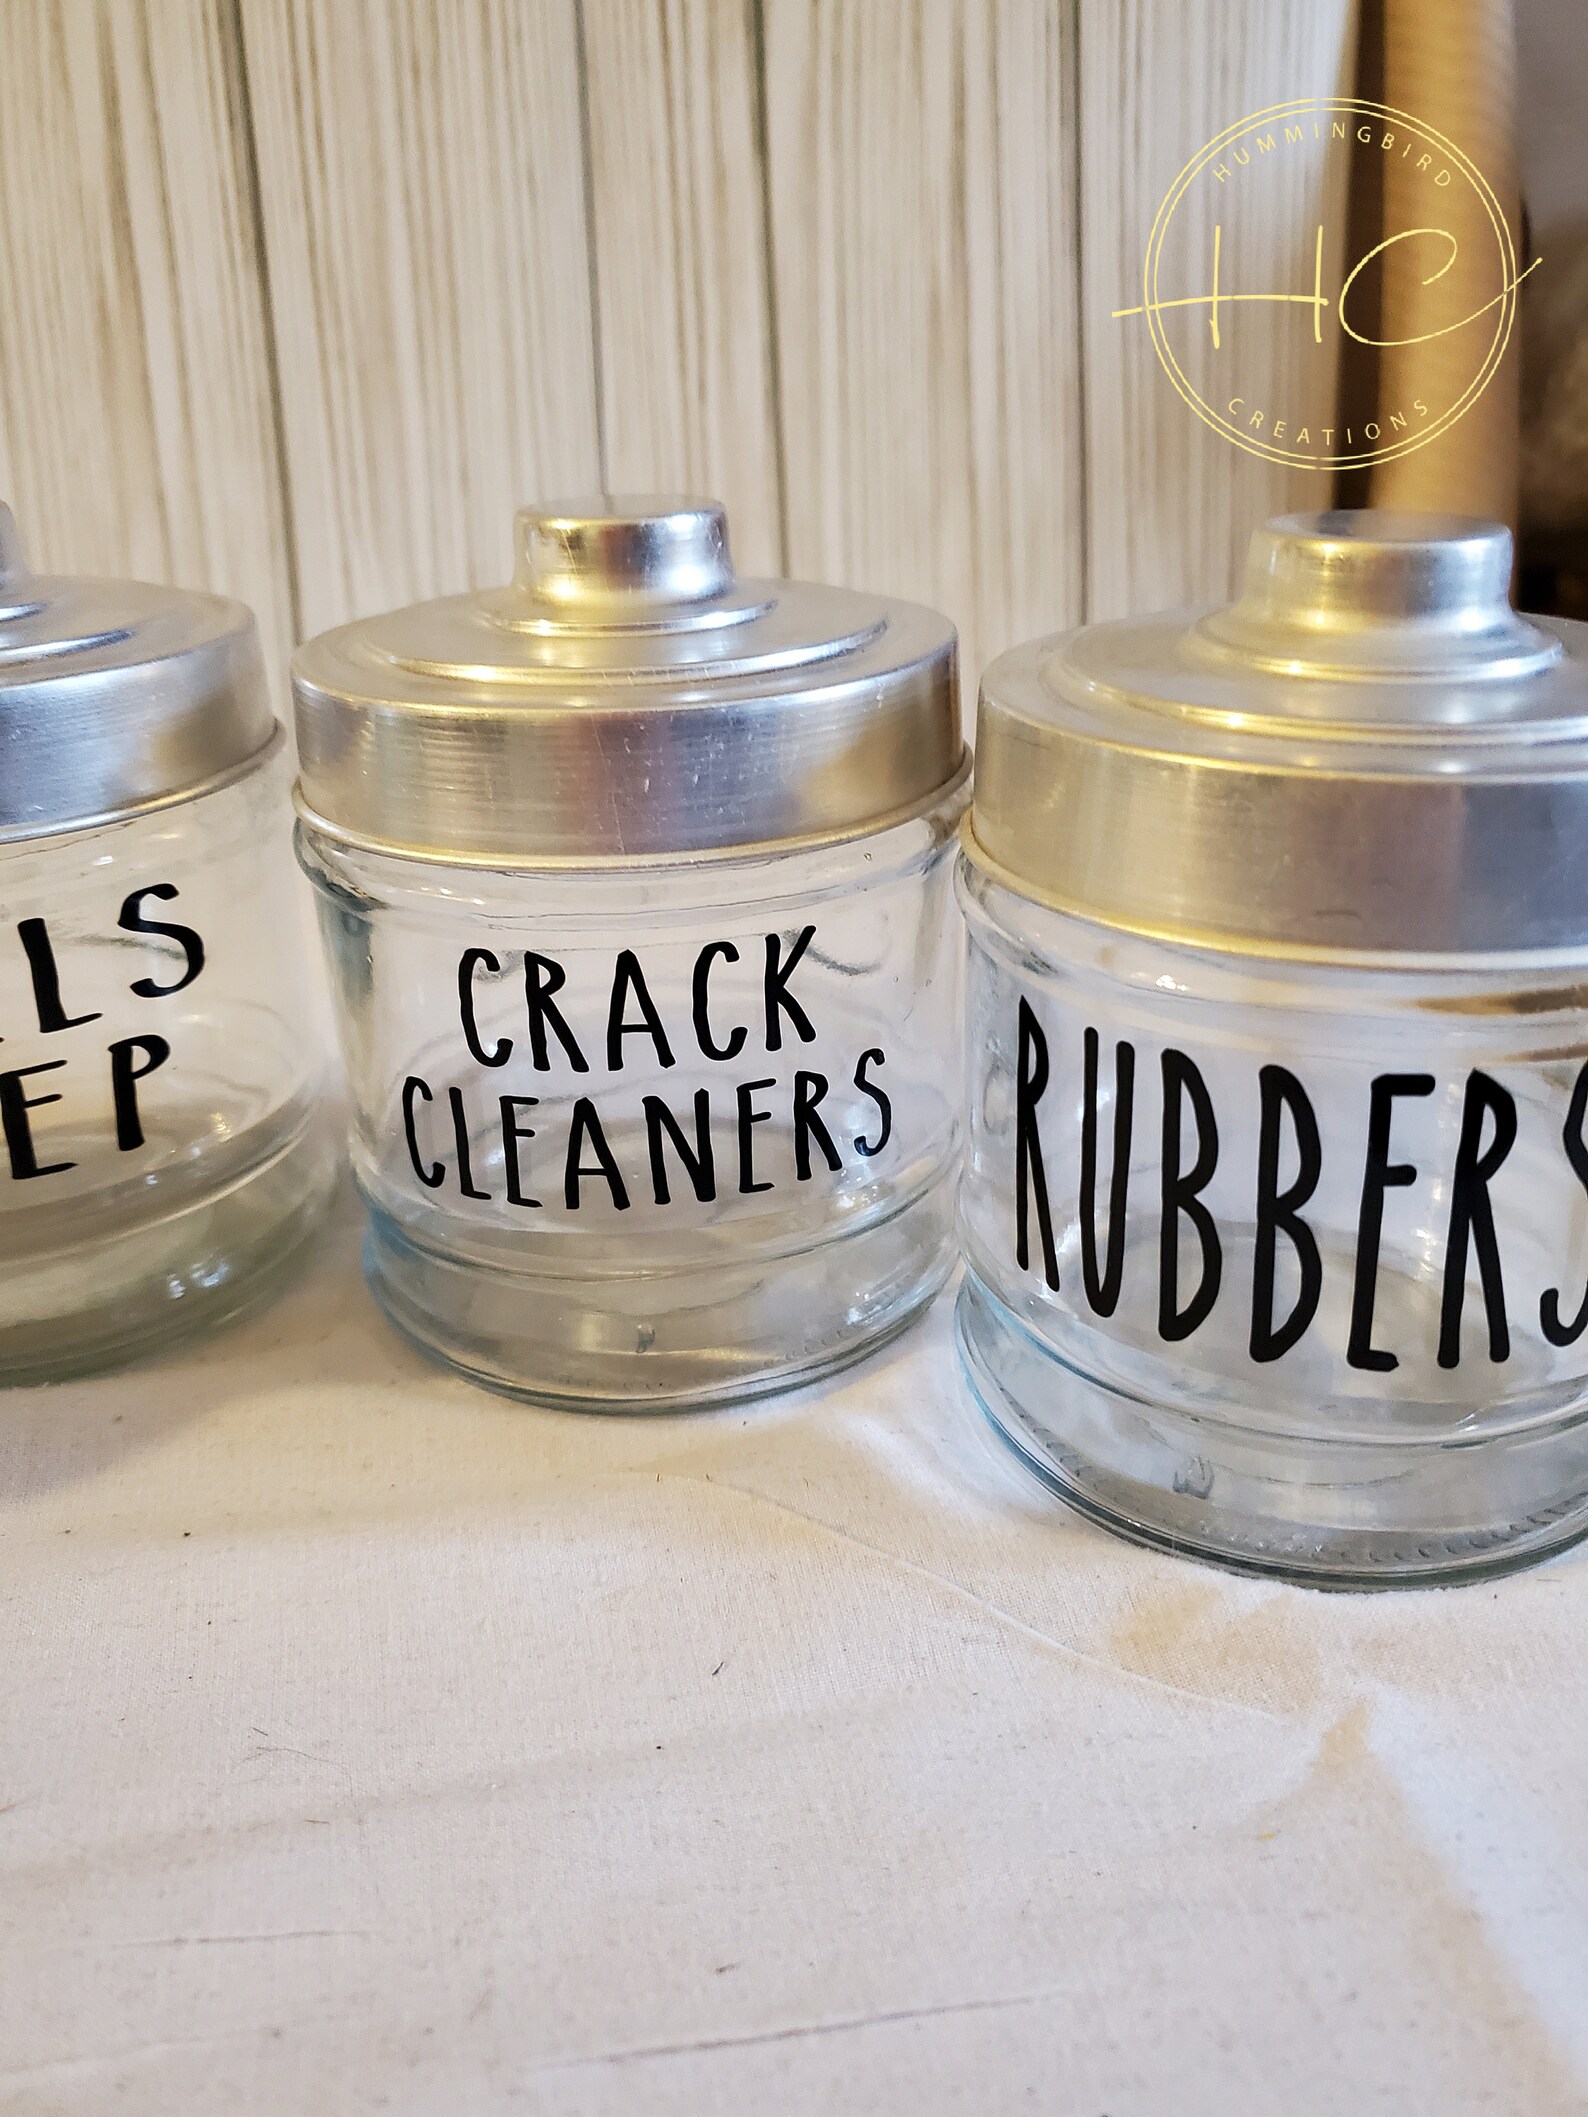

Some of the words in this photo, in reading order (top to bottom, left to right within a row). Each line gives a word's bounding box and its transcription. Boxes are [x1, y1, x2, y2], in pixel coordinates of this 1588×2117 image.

[0, 882, 206, 1043] LS
[457, 924, 817, 1073] CRACK
[402, 1047, 893, 1211] CLEANERS
